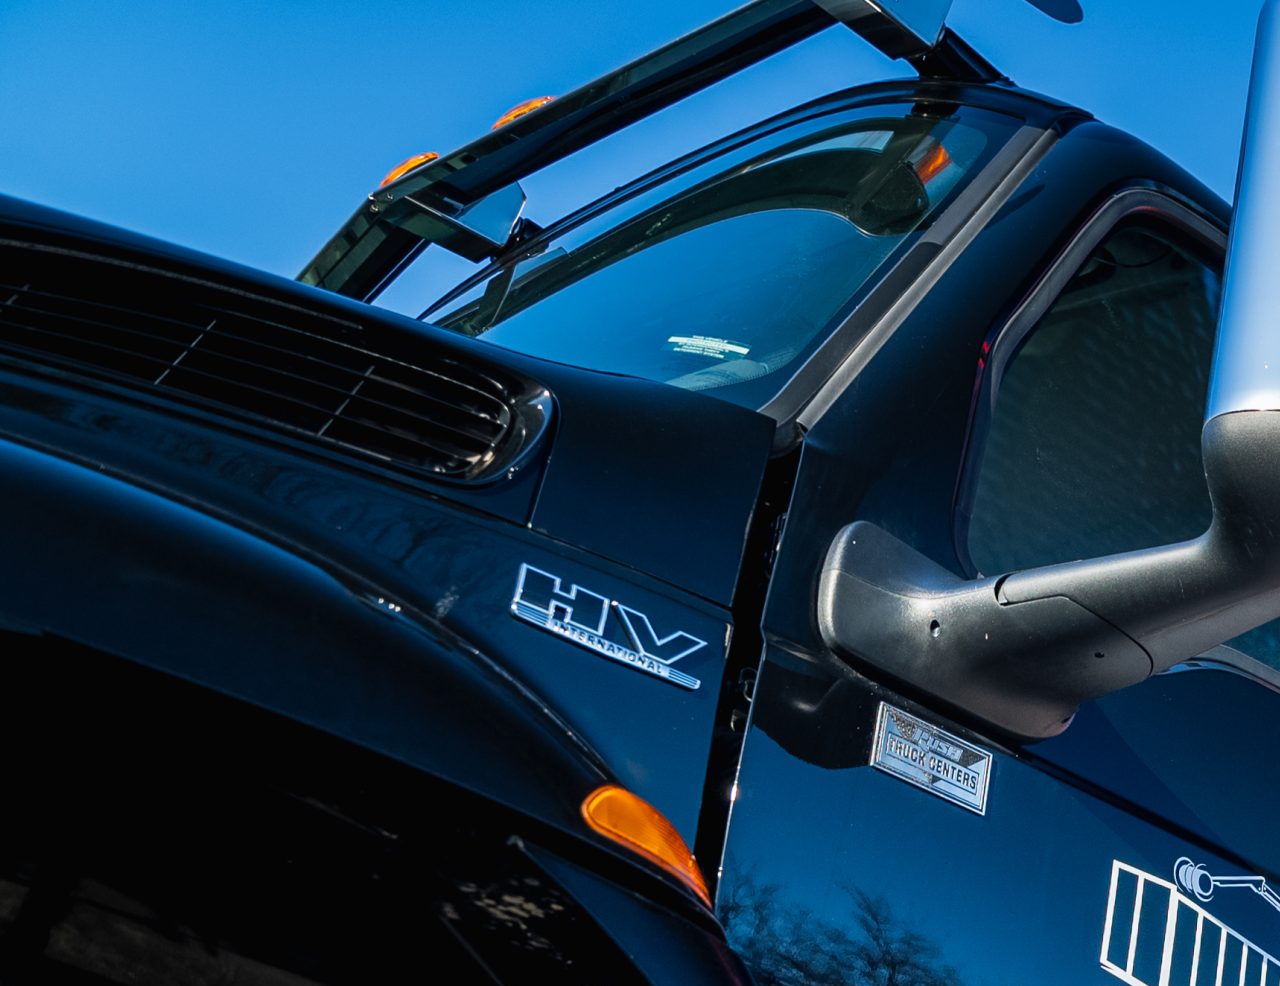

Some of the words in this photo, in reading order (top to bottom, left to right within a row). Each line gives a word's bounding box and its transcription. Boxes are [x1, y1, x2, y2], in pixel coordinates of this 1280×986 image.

[553, 619, 664, 676] INTERNATIONAL
[888, 735, 927, 767] TRUCK
[928, 756, 978, 789] CENTERS
